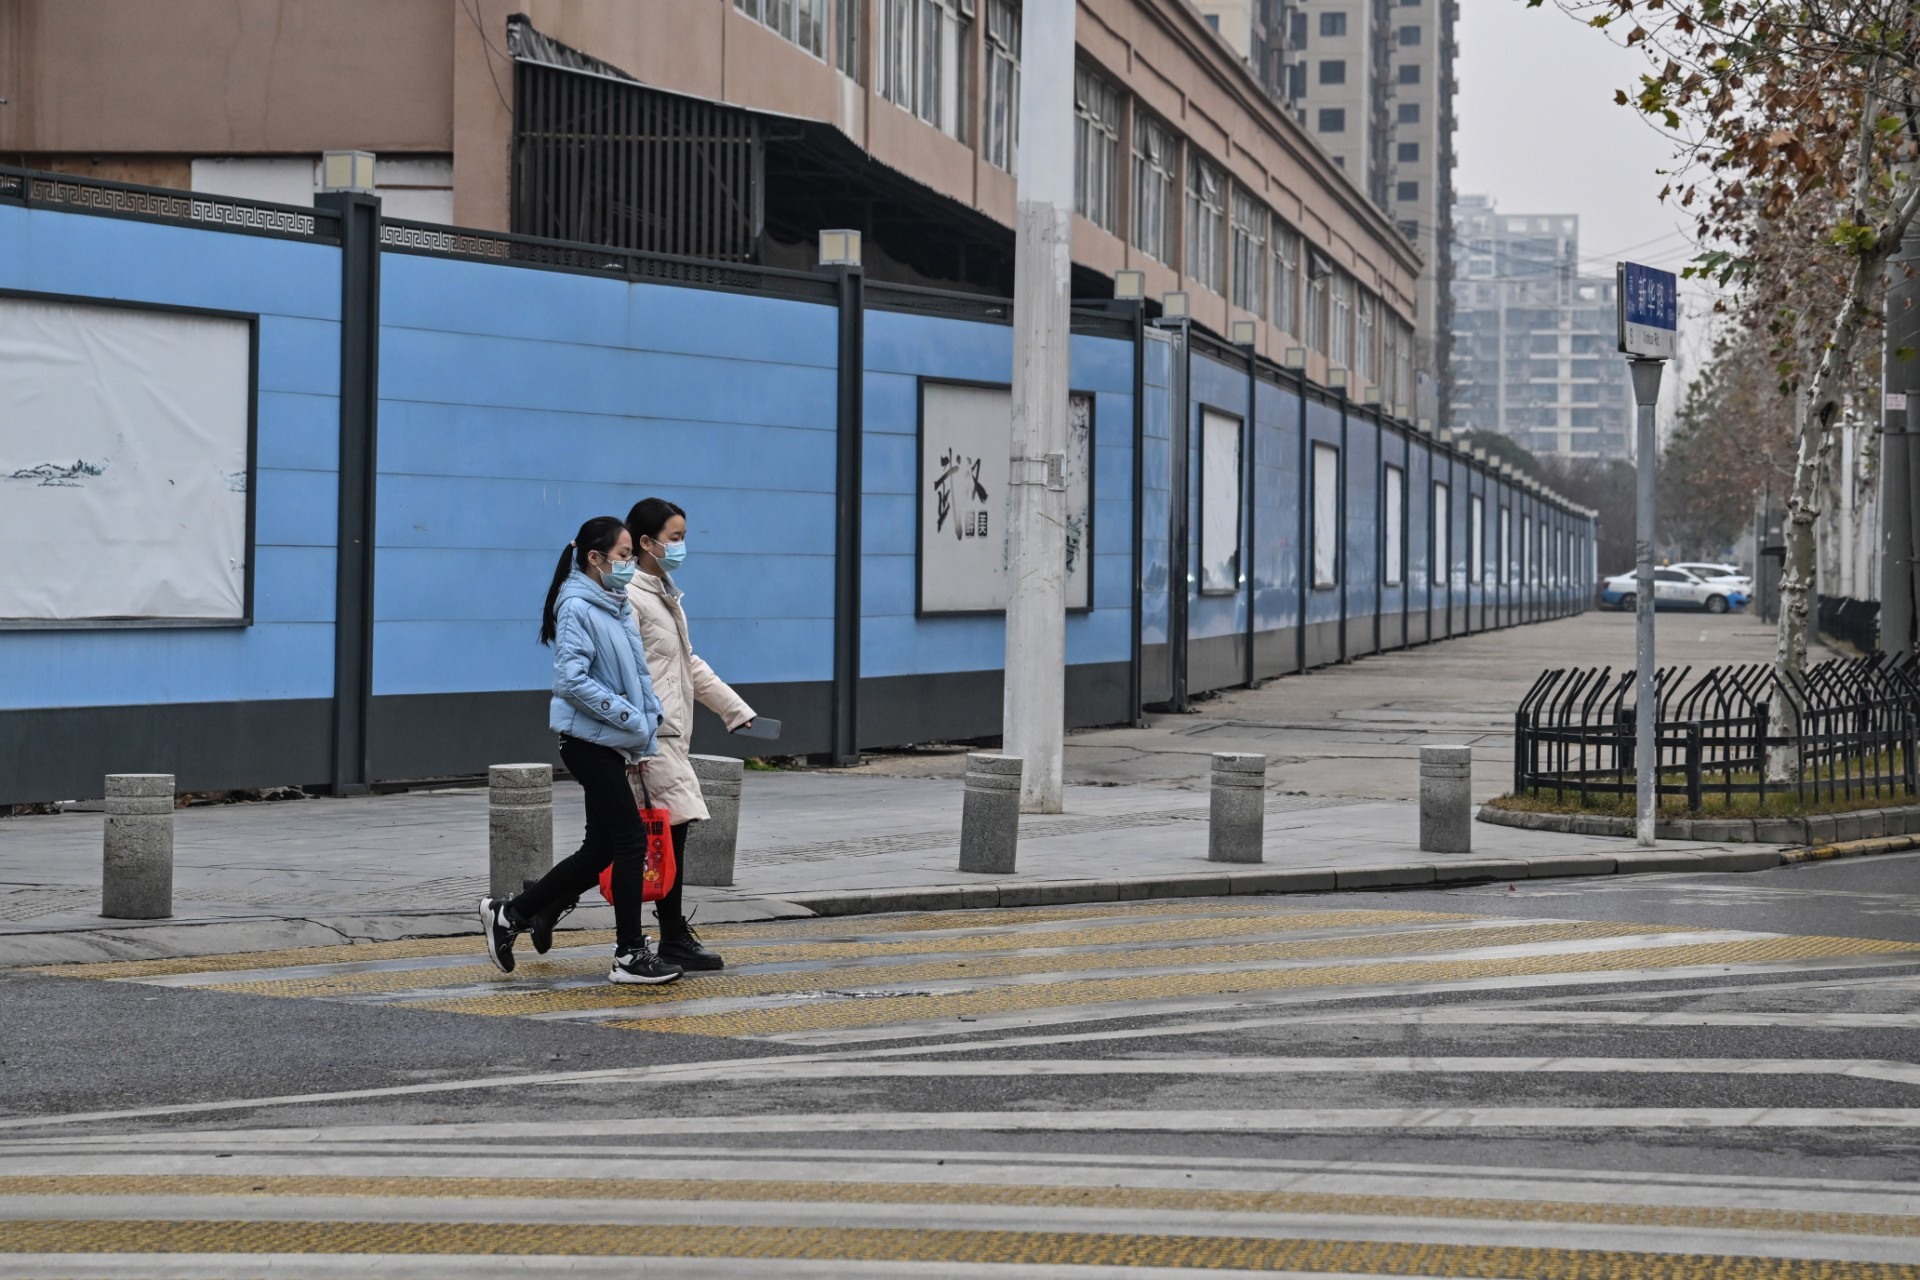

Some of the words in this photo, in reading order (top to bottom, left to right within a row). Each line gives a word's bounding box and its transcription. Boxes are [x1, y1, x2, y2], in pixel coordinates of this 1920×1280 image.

[1638, 276, 1664, 319] 新华路
[934, 447, 988, 541] 武汉
